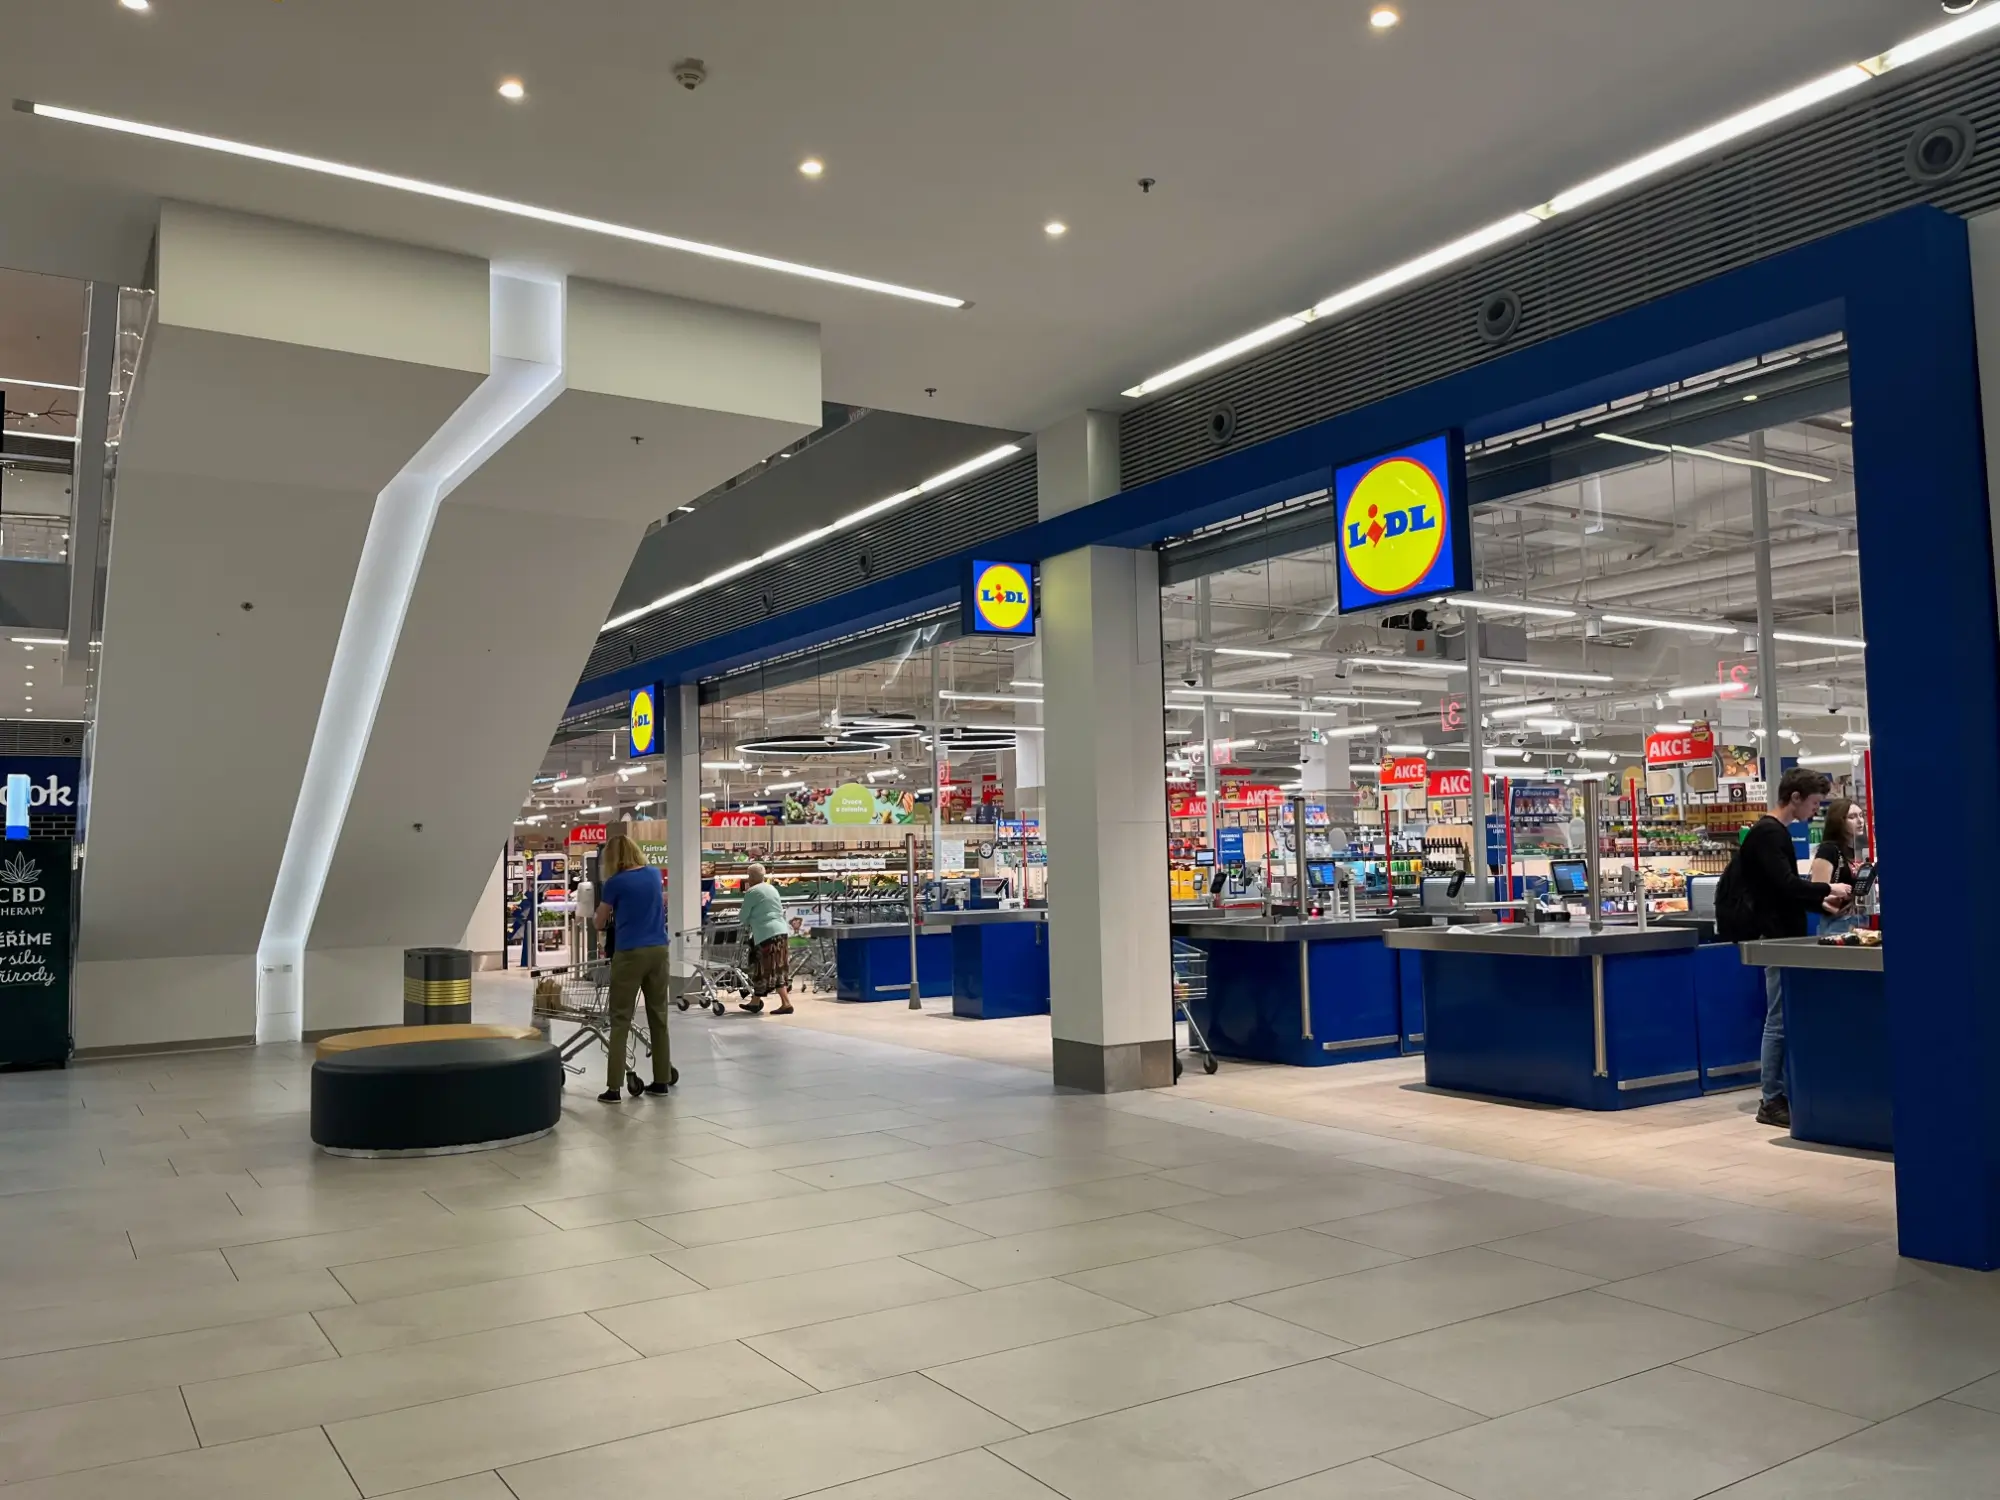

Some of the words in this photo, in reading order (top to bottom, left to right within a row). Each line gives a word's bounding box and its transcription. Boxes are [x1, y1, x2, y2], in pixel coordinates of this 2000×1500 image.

[1649, 738, 1693, 758] AKCE
[1393, 763, 1425, 780] AKCE
[1439, 774, 1471, 794] AKC
[1188, 801, 1208, 814] AKC
[579, 828, 607, 841] AKC
[642, 844, 668, 853] Fairtrad
[0, 906, 45, 916] HERAPY
[0, 965, 56, 987] řírody
